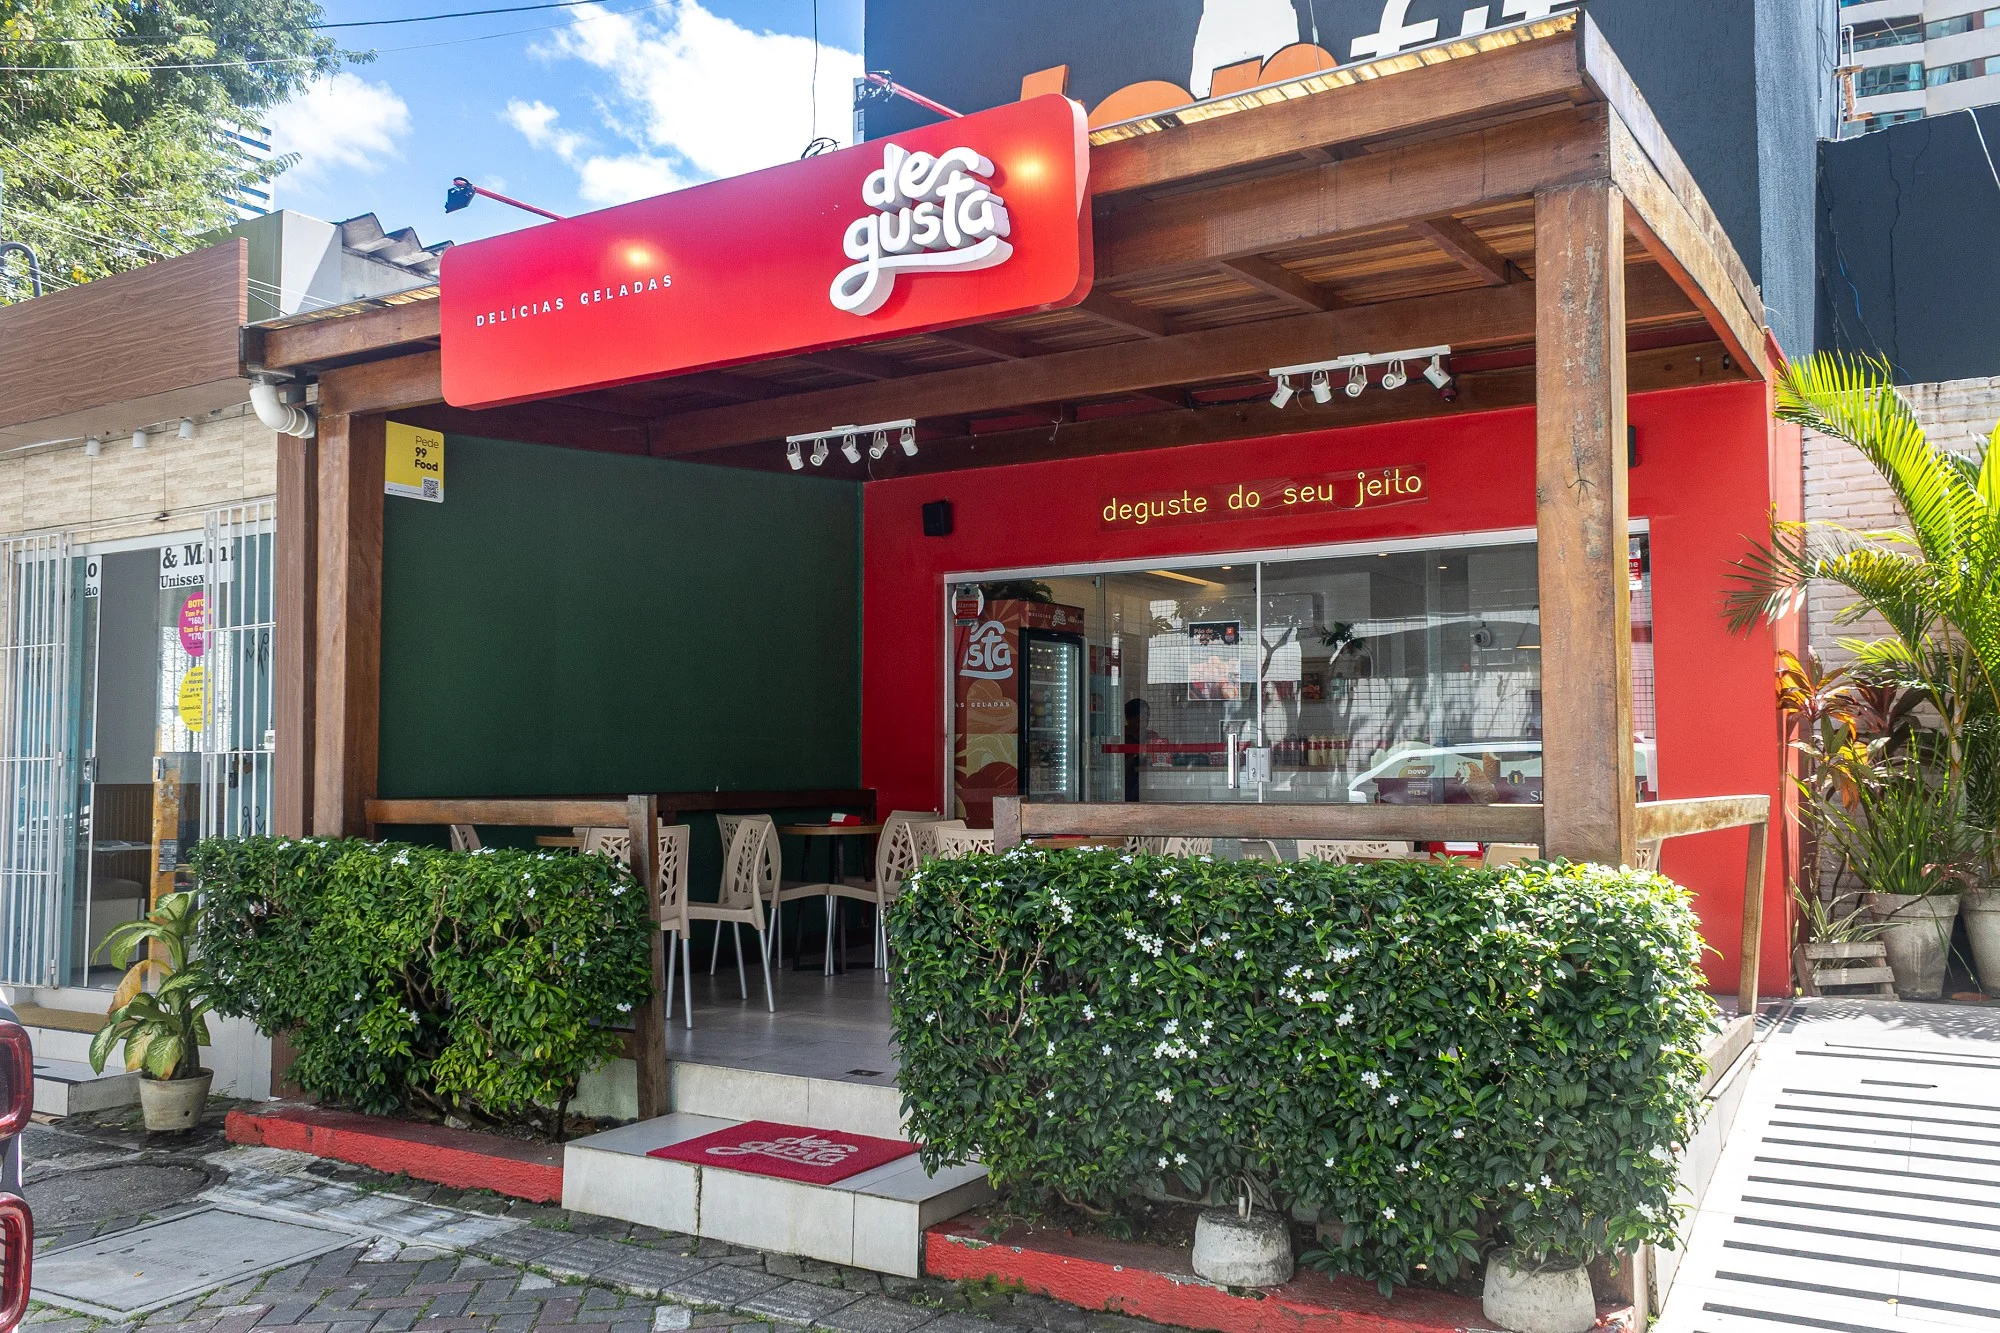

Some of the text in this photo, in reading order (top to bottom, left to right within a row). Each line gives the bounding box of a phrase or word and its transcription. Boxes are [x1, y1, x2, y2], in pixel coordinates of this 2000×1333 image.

[862, 142, 995, 212] de
[829, 170, 1014, 316] gusta
[476, 275, 672, 327] DELÍCIAS GELADAS
[414, 459, 438, 471] Food
[415, 435, 439, 448] Pede
[415, 447, 427, 458] 99
[1103, 469, 1422, 524] deguste do seu jeito
